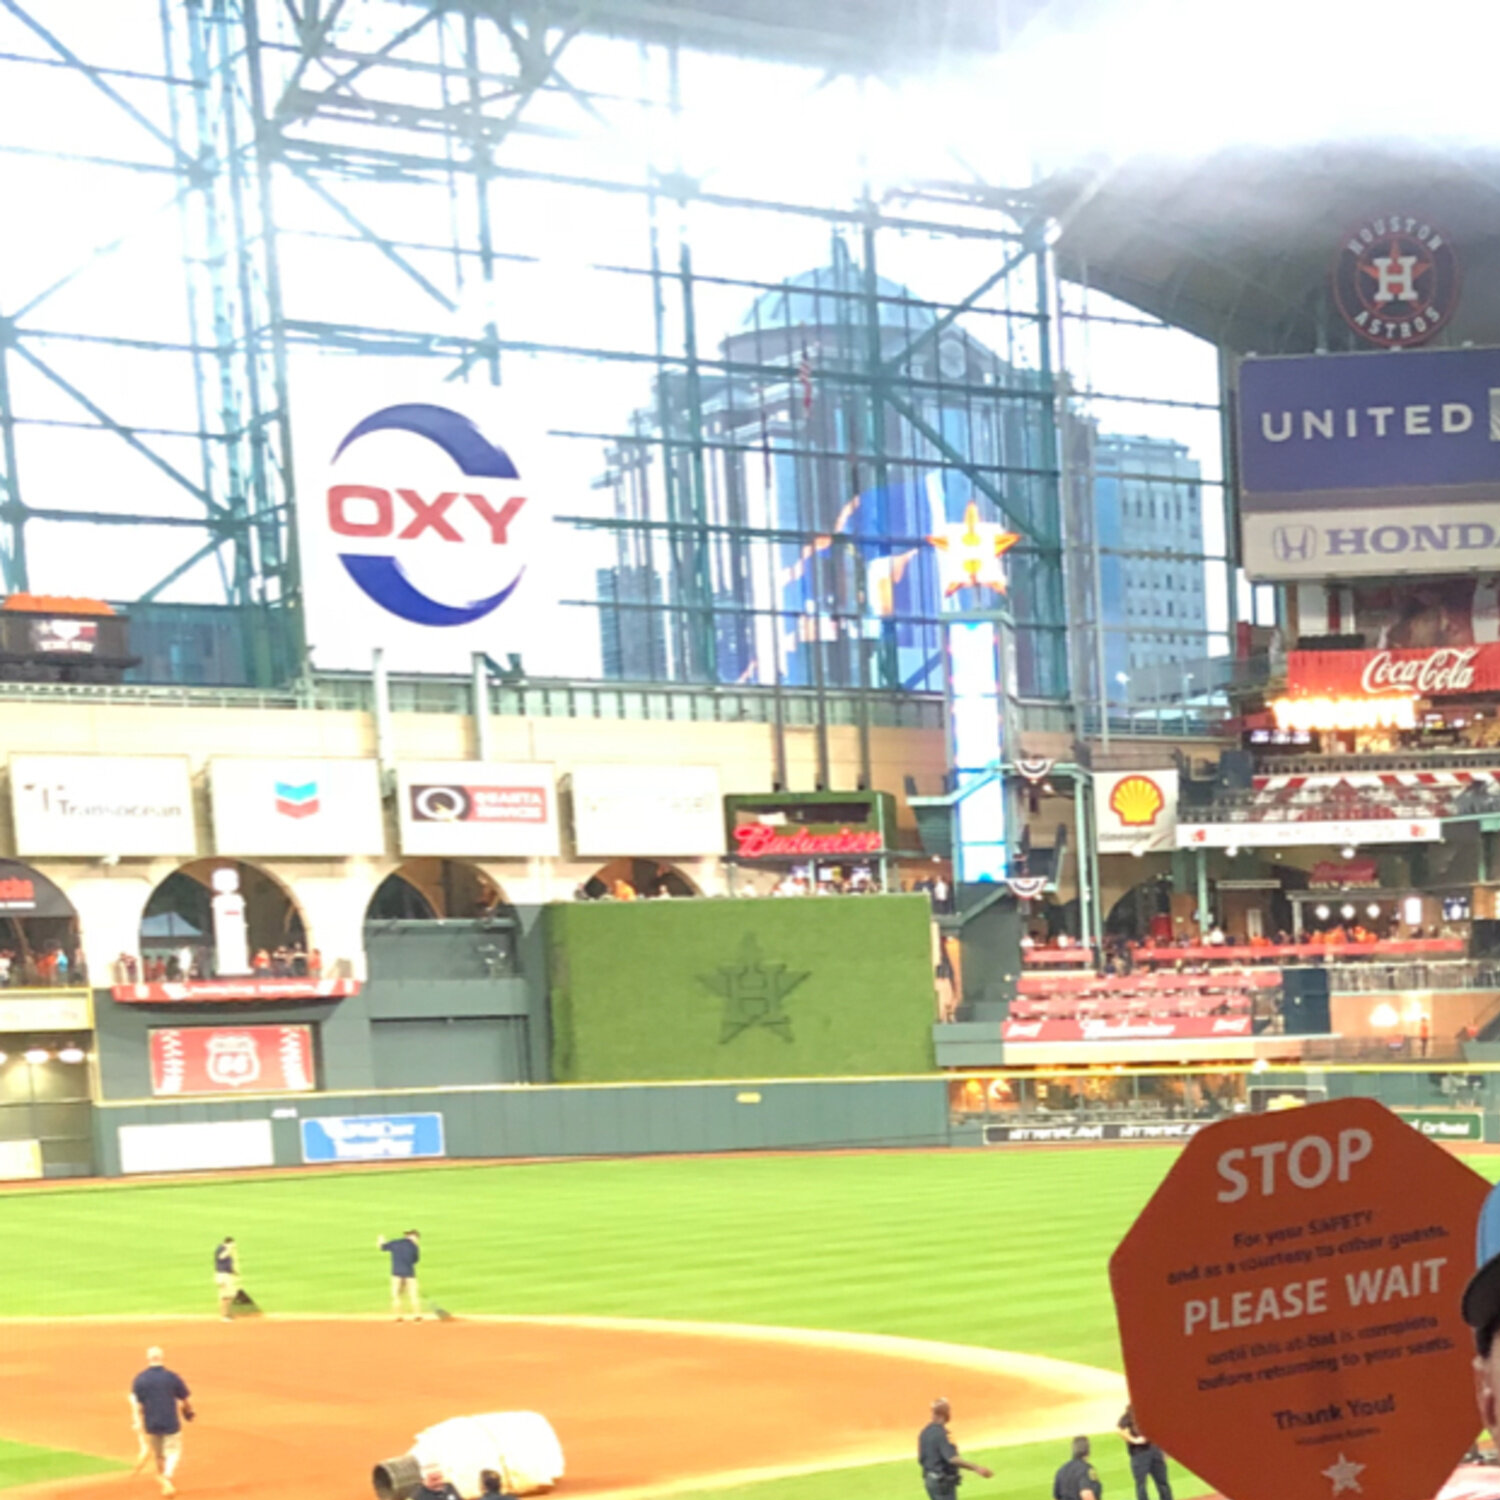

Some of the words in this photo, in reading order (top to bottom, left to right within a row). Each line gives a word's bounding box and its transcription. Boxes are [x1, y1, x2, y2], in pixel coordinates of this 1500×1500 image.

[1346, 216, 1443, 255] HOUSTON
[1354, 306, 1441, 339] ASTROS
[1261, 403, 1474, 442] UNITED
[326, 484, 528, 545] OXY
[1361, 647, 1478, 694] Coca-Cola
[733, 822, 882, 858] Budweiser
[1216, 1128, 1373, 1204] STOP
[1233, 1232, 1262, 1249] For
[1267, 1225, 1304, 1247] your
[1308, 1209, 1374, 1235] SAFETY
[1167, 1266, 1199, 1286] and
[1239, 1249, 1313, 1273] courtesy
[1338, 1233, 1384, 1255] other
[1183, 1277, 1329, 1337] PLEASE
[1344, 1256, 1449, 1308] WAIT
[1357, 1315, 1439, 1343] complete
[1197, 1369, 1255, 1393] before
[1257, 1355, 1340, 1384] returning
[1272, 1402, 1344, 1431] Thank
[1346, 1393, 1395, 1418] You!
